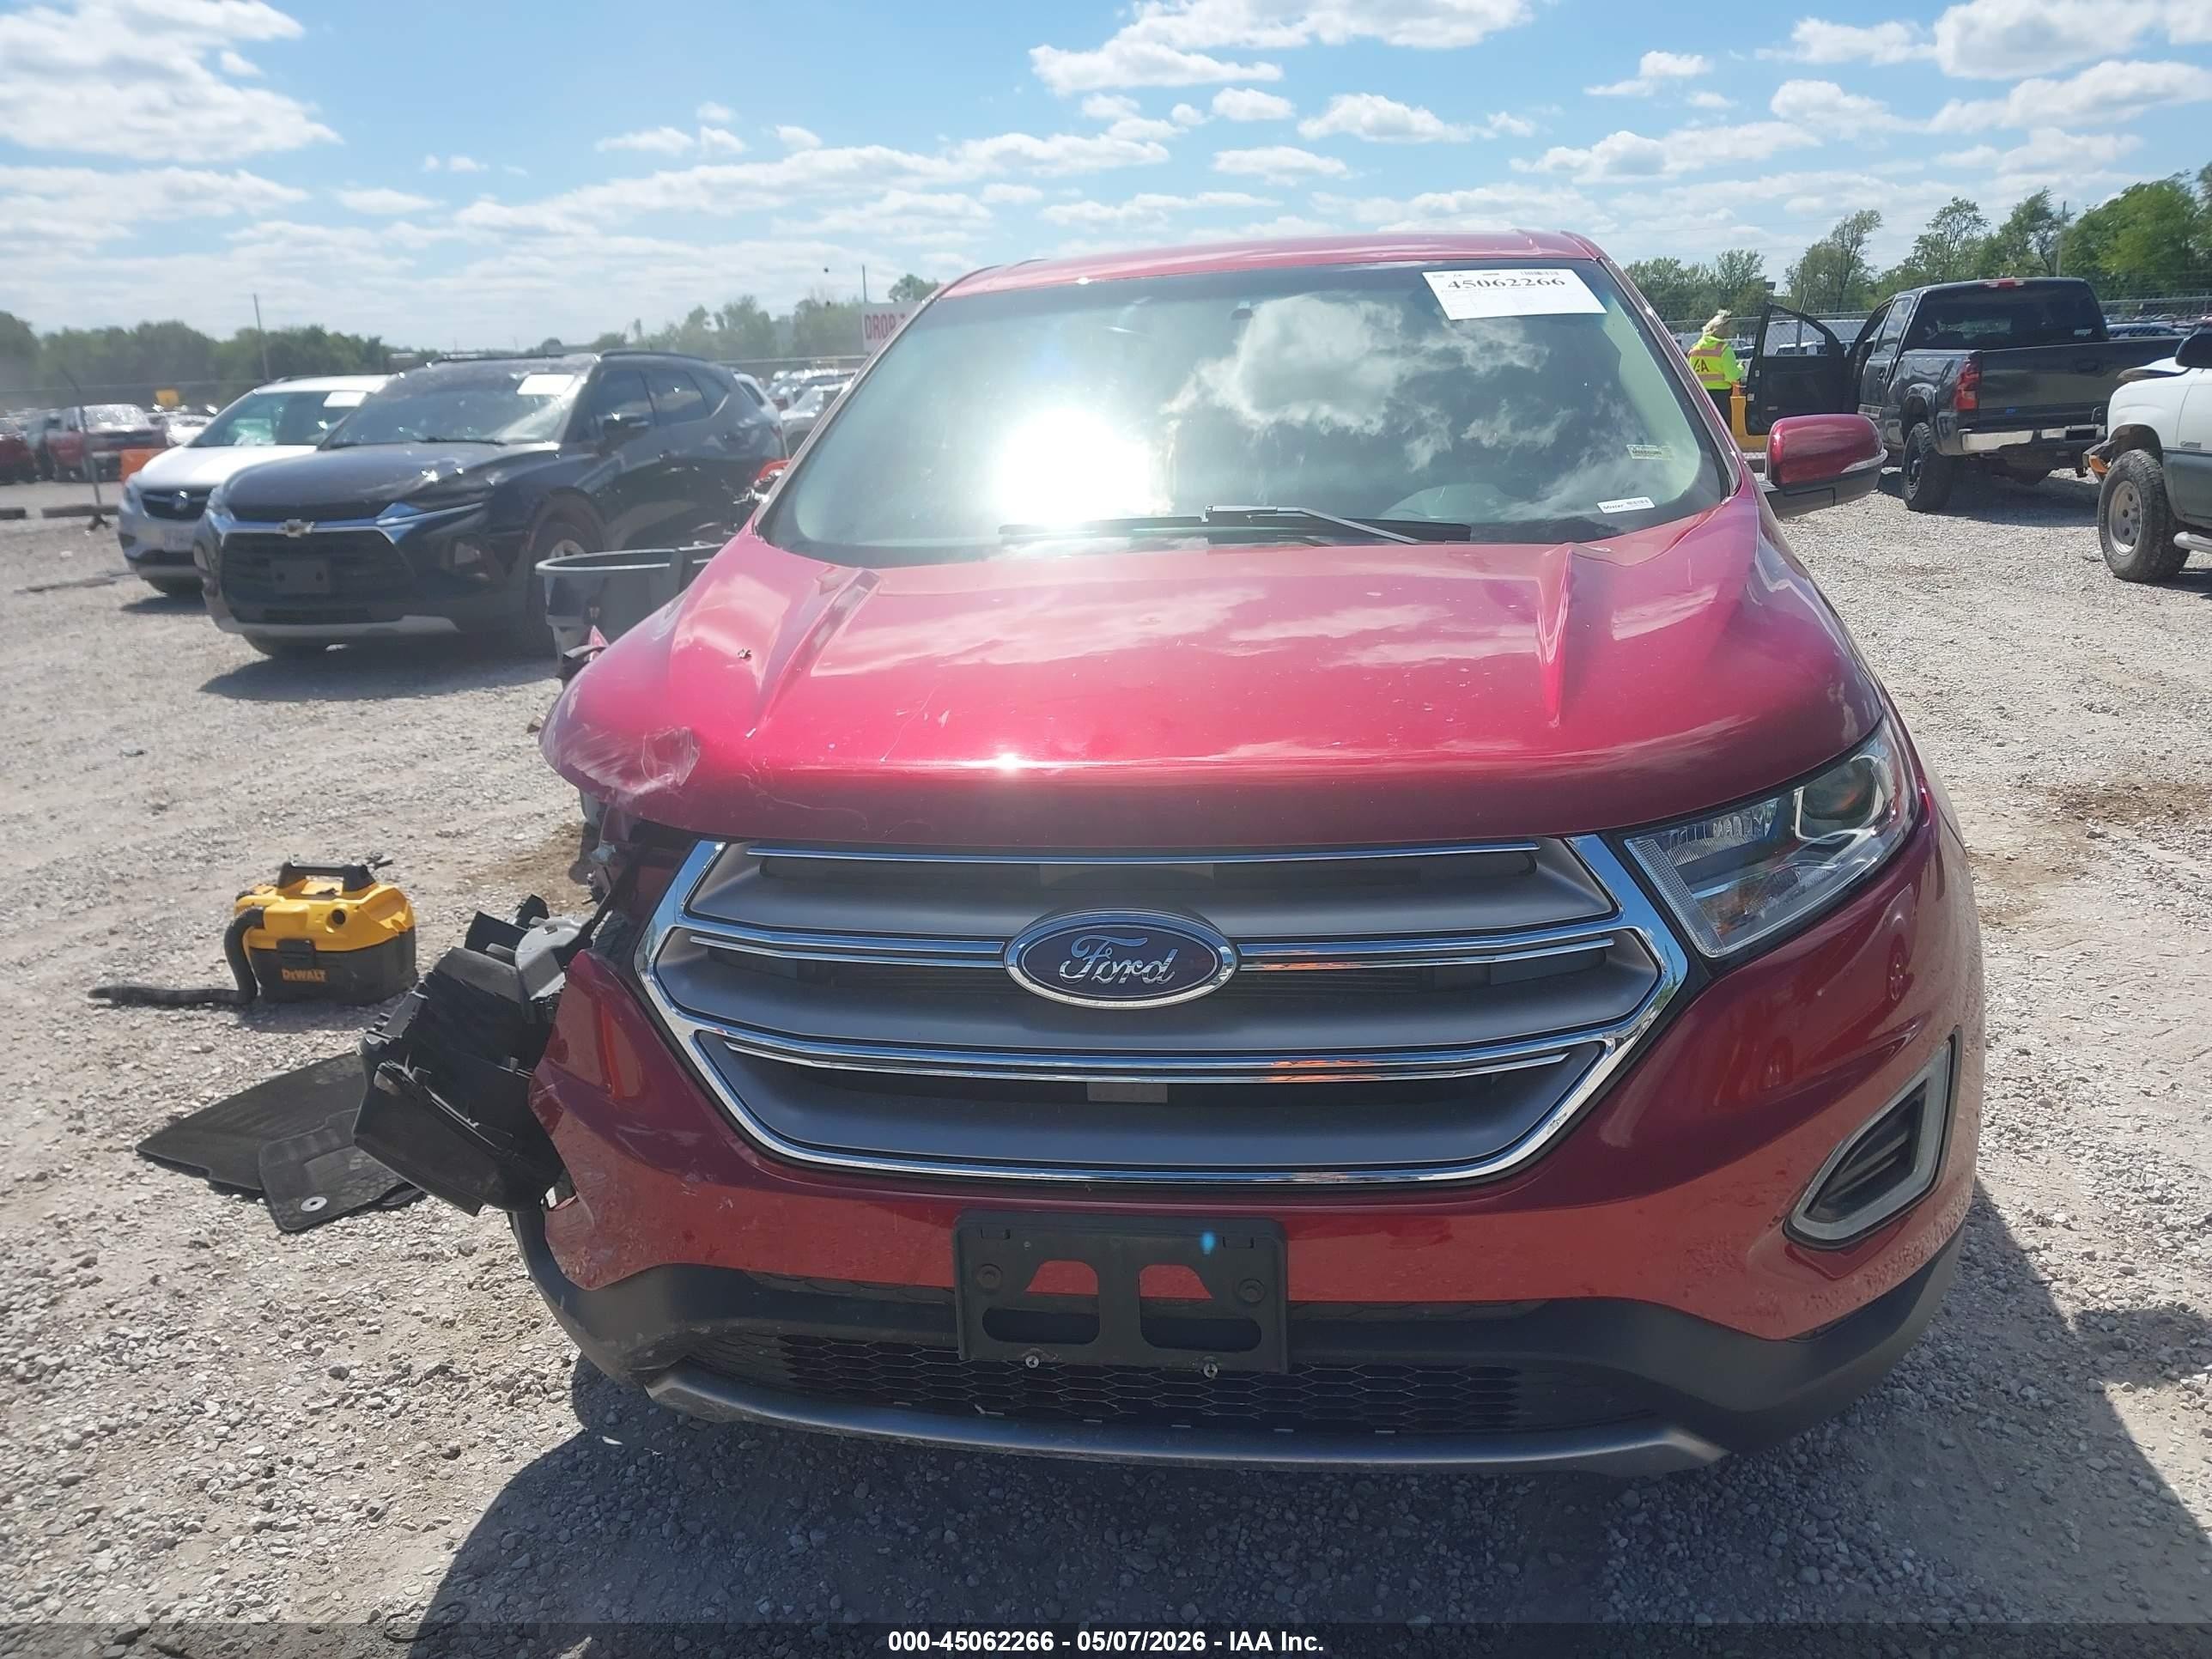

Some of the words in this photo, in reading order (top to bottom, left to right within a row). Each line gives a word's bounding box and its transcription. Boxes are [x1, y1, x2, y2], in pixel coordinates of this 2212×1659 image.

[1448, 277, 1565, 289] 45062266
[864, 313, 896, 340] DROP
[1059, 934, 1179, 984] Ford
